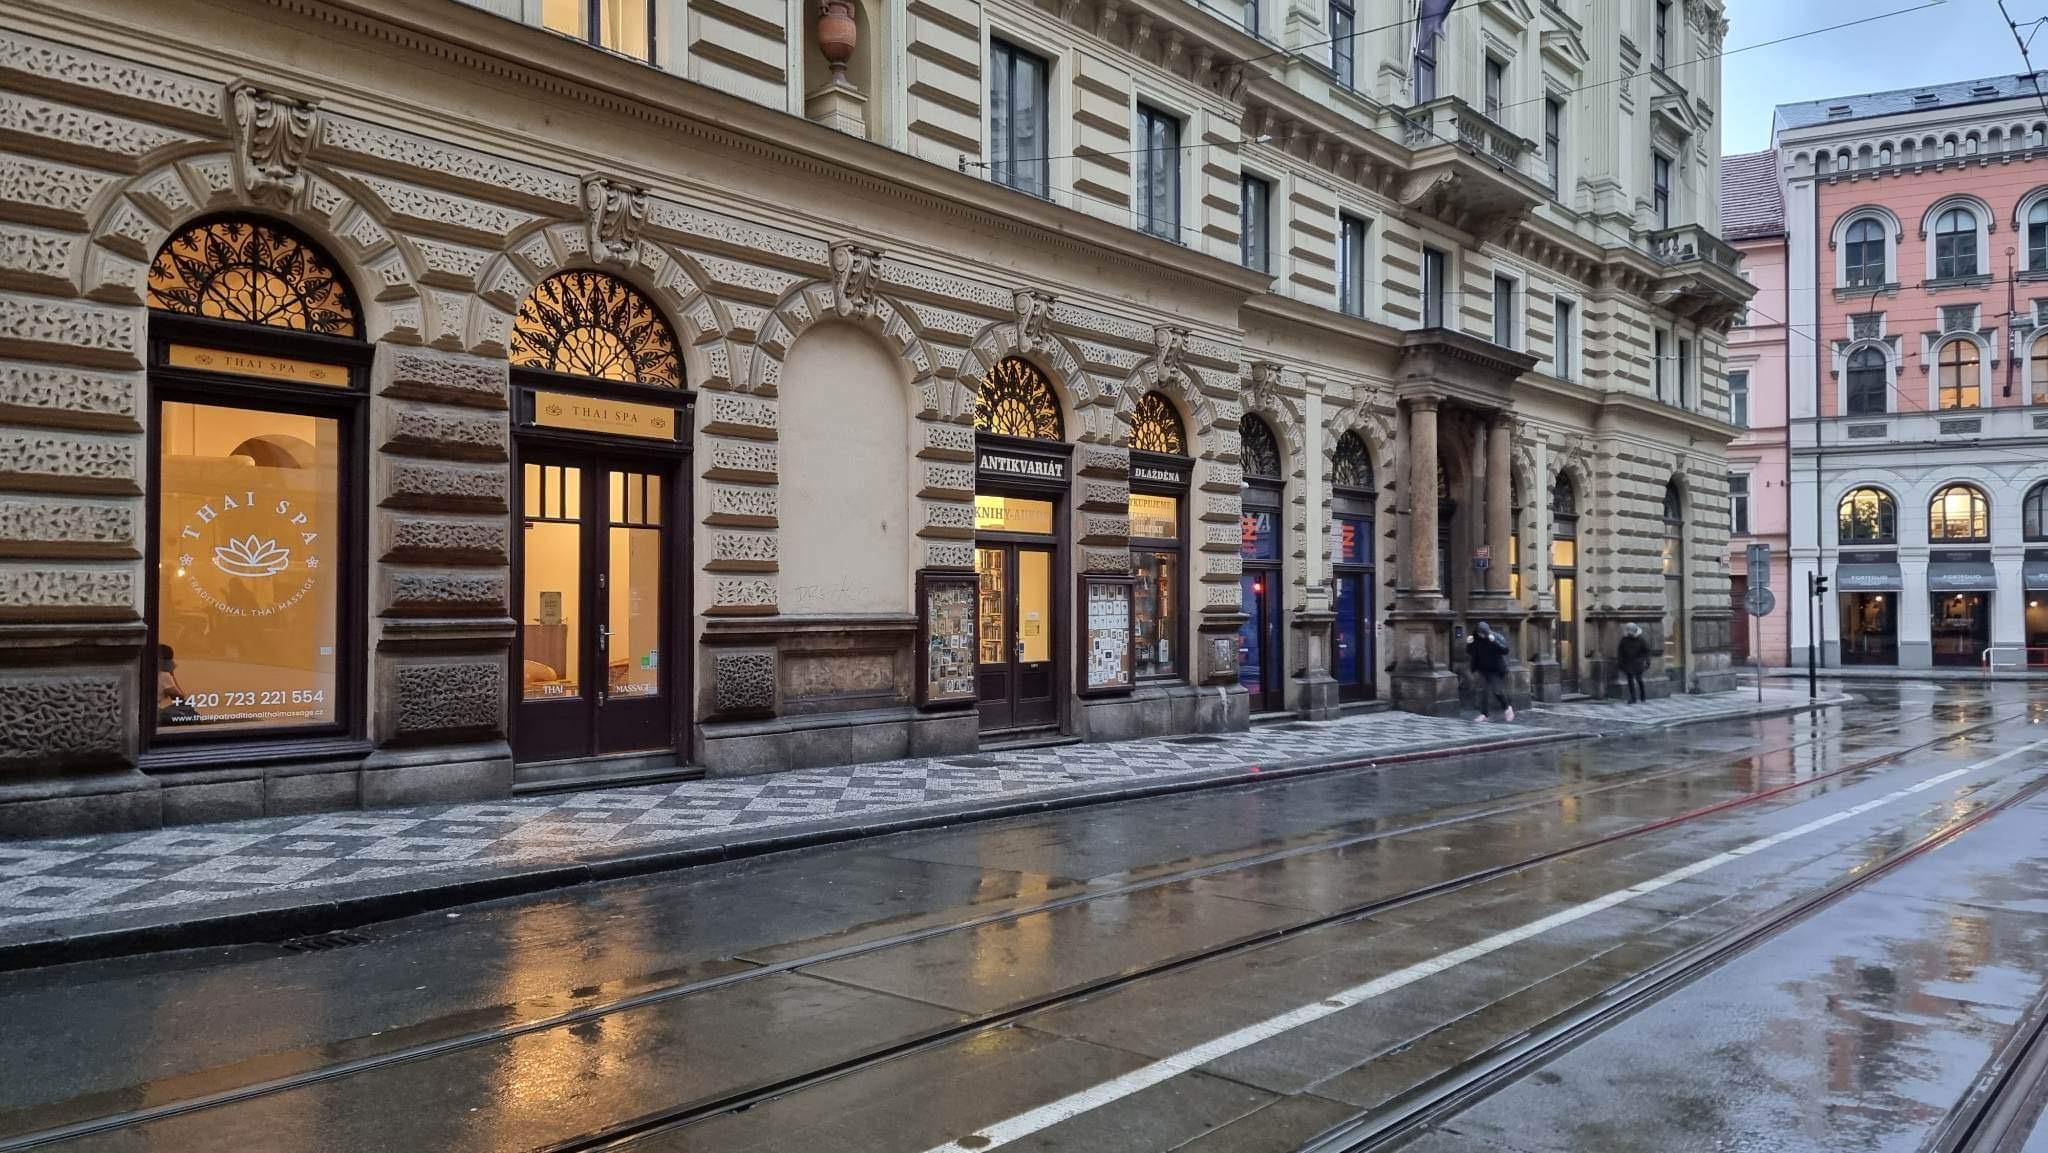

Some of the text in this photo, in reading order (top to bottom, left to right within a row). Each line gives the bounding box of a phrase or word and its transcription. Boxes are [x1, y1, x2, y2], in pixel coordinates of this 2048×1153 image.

[225, 356, 262, 369] THAI
[271, 363, 295, 373] SPA
[572, 406, 607, 419] THAI
[615, 411, 638, 423] SPA
[980, 455, 1062, 476] ANTIKVARIÁT
[182, 491, 317, 545] THAI SPA
[189, 576, 315, 616] TRADITIONAL THAI MASSAGE
[172, 689, 324, 708] +420 723 221 554
[543, 685, 563, 694] THAI
